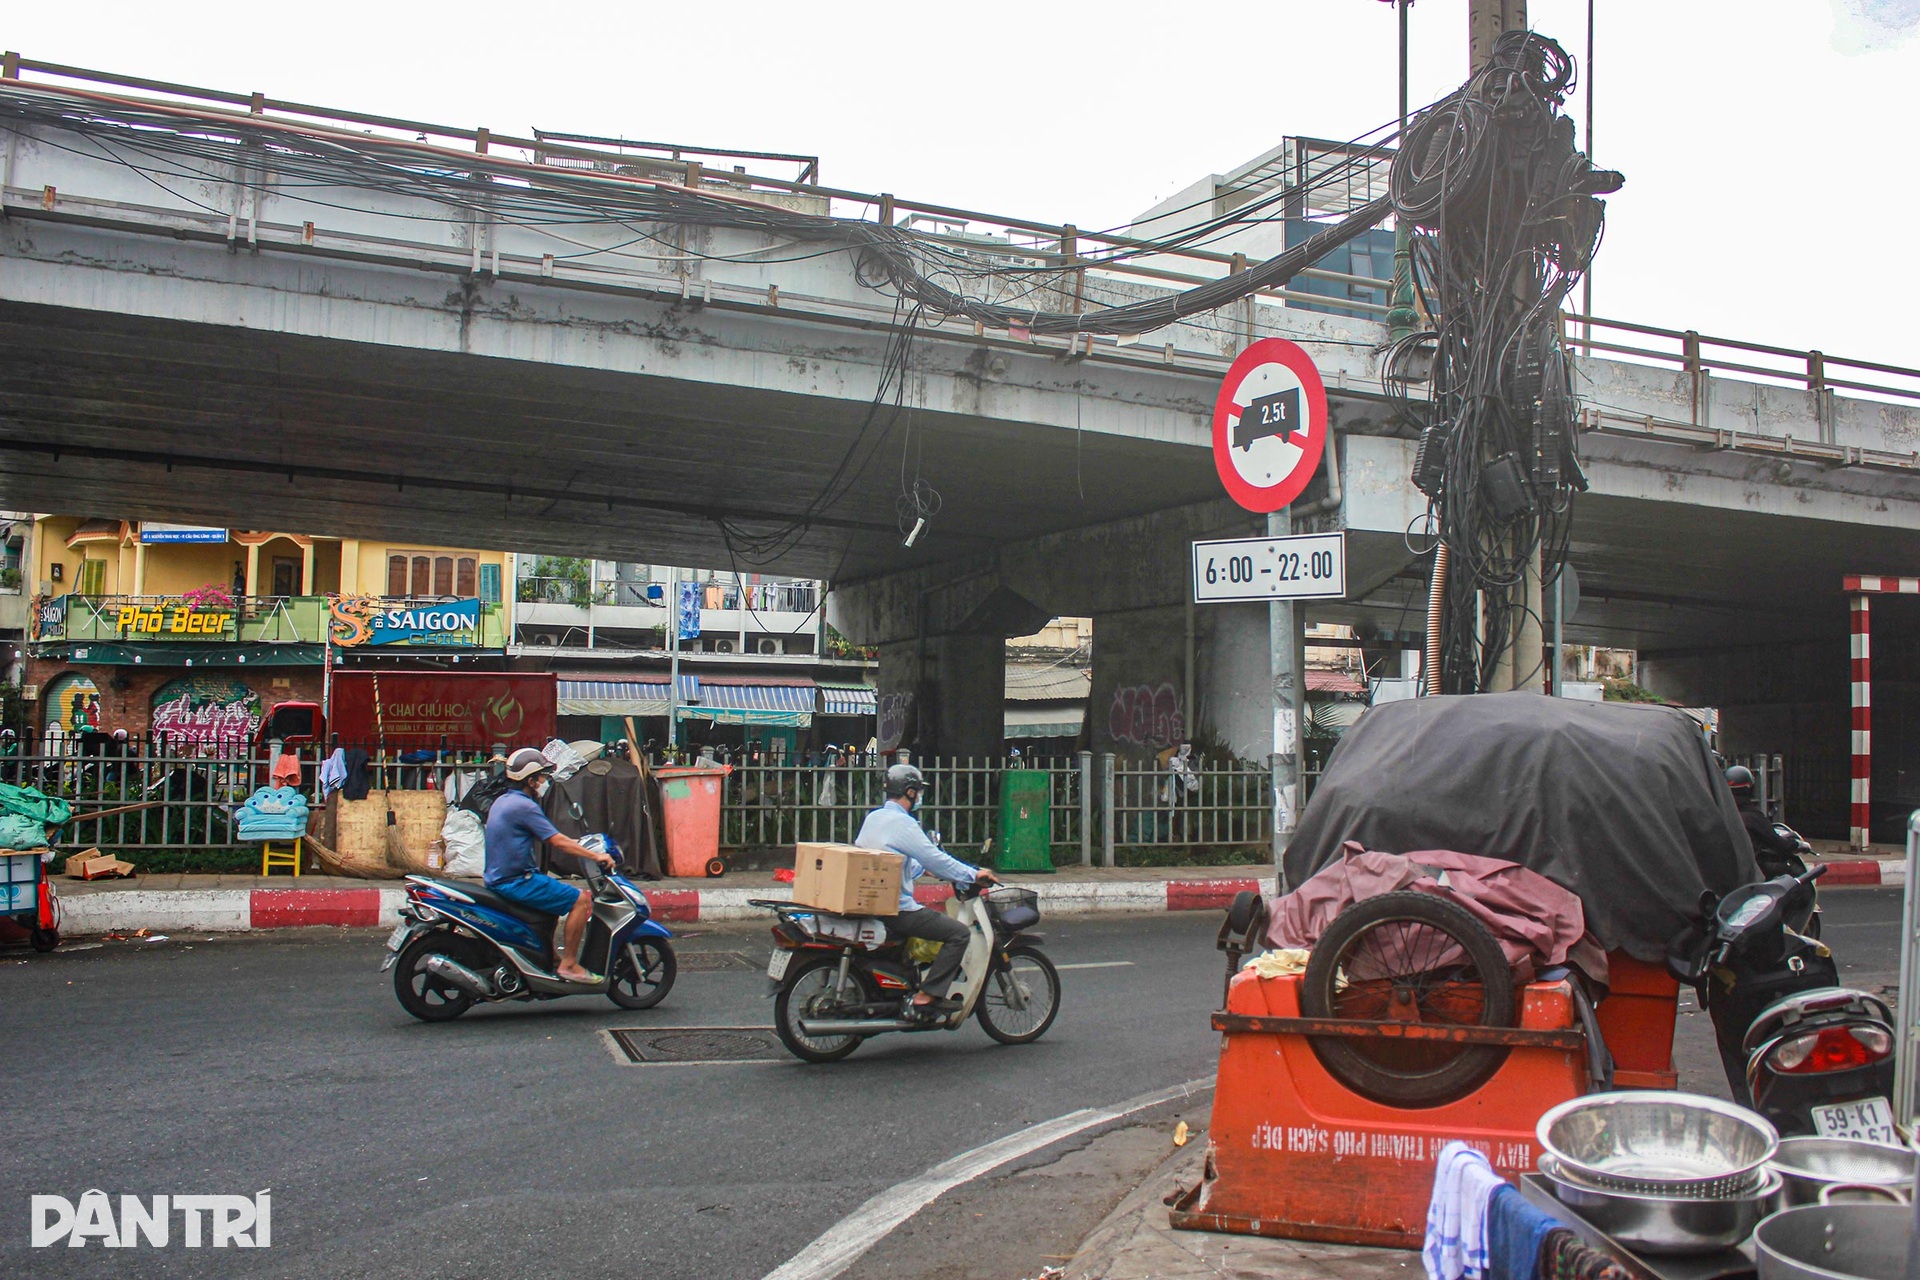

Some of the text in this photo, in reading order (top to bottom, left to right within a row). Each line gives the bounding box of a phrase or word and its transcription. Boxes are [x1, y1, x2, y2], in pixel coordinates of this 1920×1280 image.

[1261, 401, 1286, 425] 2.5t
[1205, 555, 1253, 585] 6:00
[1278, 550, 1332, 581] 22:00
[116, 601, 230, 633] Phố Beer
[375, 610, 475, 631] BIA SAIGON
[408, 632, 473, 646] CHILL
[389, 704, 414, 717] CHAI
[418, 699, 442, 717] CHÚ
[1288, 1124, 1328, 1153] SẠCH
[1333, 1131, 1366, 1164] PHỐ
